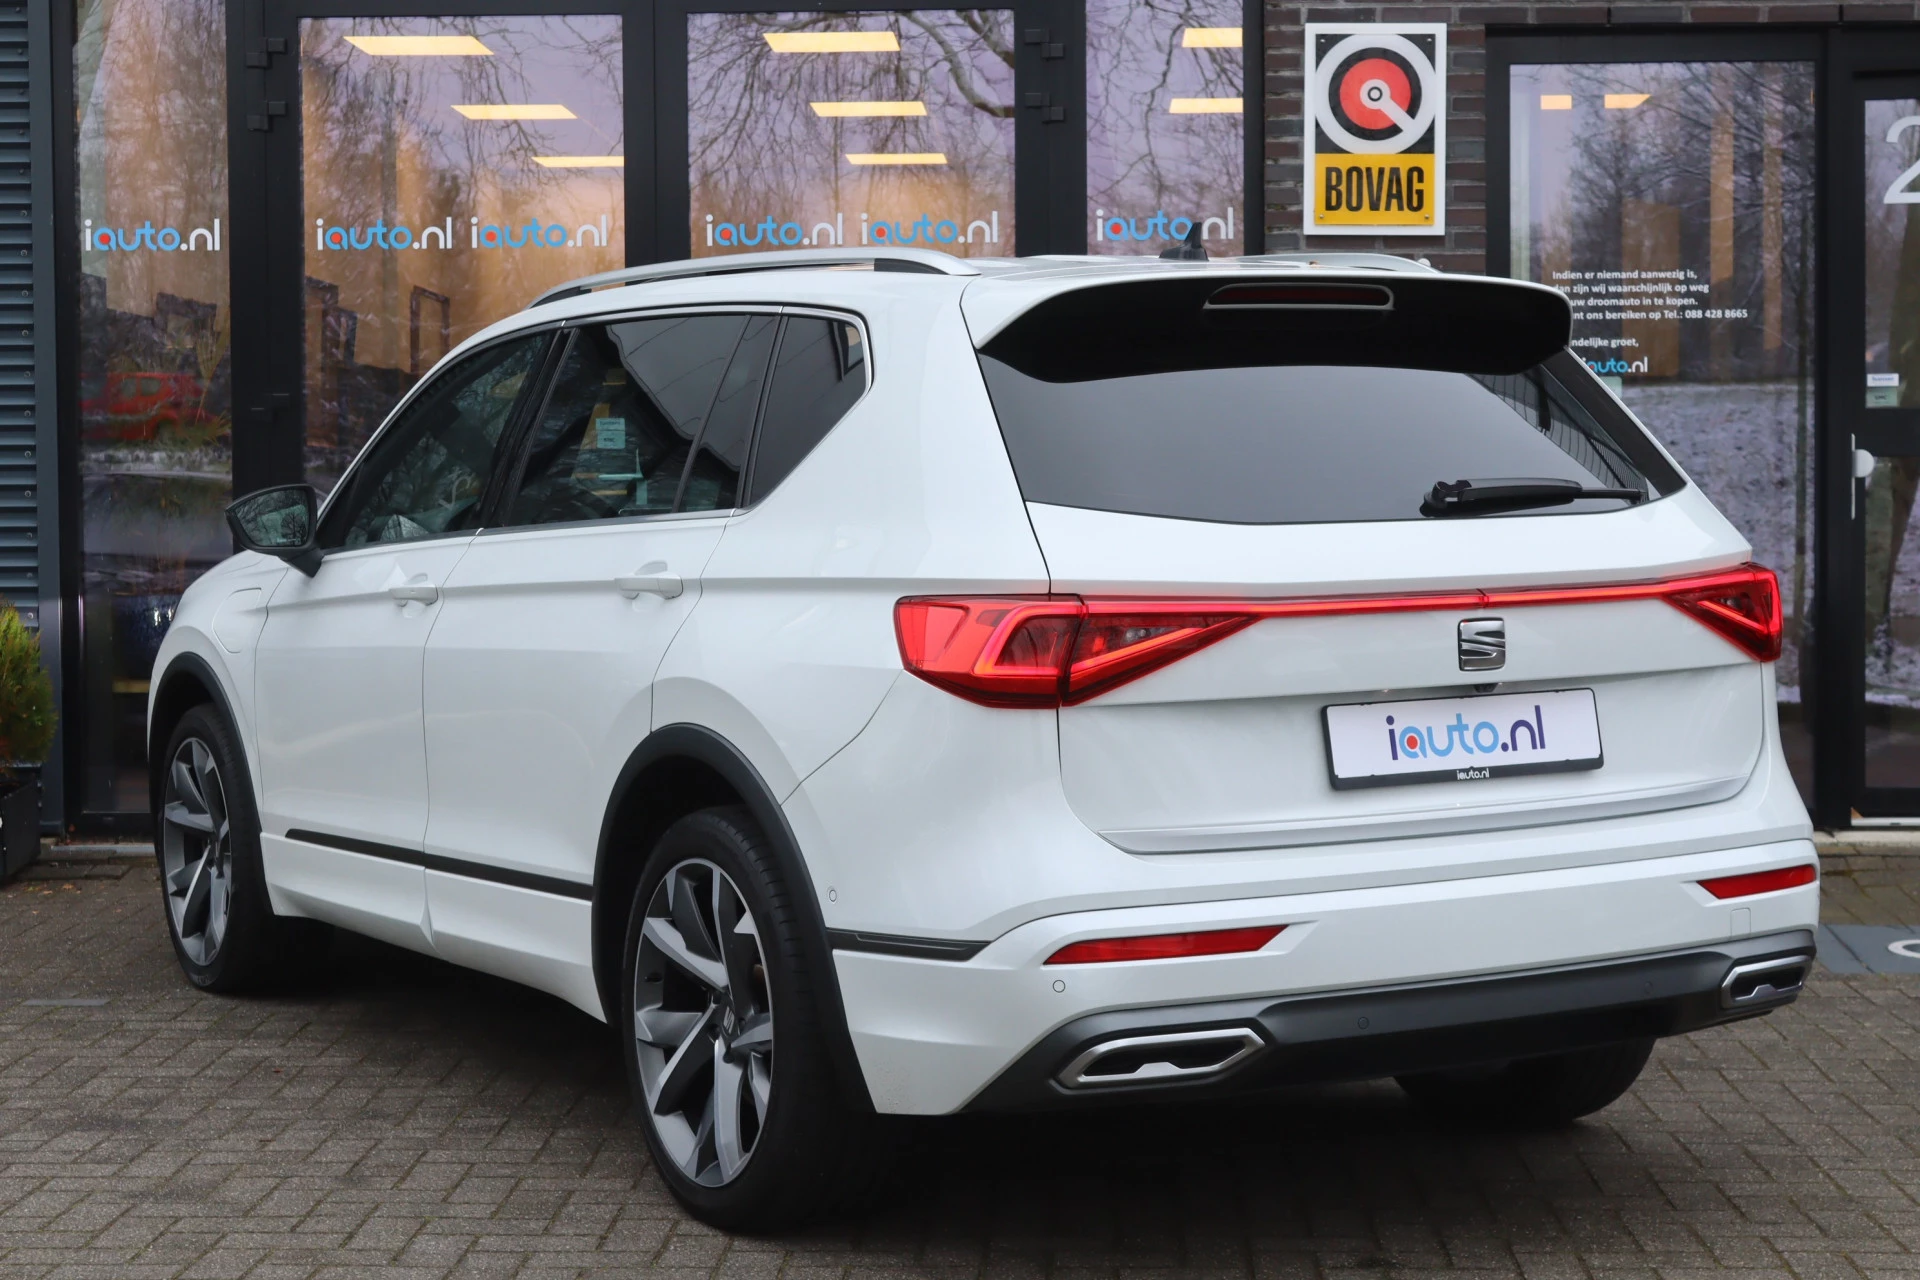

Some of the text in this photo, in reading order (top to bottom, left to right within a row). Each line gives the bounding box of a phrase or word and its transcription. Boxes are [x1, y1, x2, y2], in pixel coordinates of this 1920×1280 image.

[1325, 166, 1425, 212] BOVAG
[84, 218, 220, 251] iauto.nl
[316, 216, 452, 250] iauto.nl
[471, 215, 608, 249] iauto.nl
[706, 213, 843, 246] iauto.nl
[861, 211, 998, 245] iauto.nl
[1096, 207, 1233, 241] iautonl
[1552, 270, 1582, 279] Indien
[1597, 269, 1639, 279] niemand
[1640, 269, 1685, 280] aanwezig
[1687, 269, 1697, 279] is,
[1572, 283, 1589, 294] zijn
[1591, 283, 1606, 294] wij
[1608, 282, 1673, 294] waarschijnlijk
[1674, 284, 1687, 293] op
[1689, 284, 1709, 293] weg
[1586, 311, 1603, 320] ons
[1605, 310, 1646, 319] bereiken
[1649, 311, 1661, 320] op
[1685, 309, 1703, 318] 088
[1704, 309, 1722, 318] 428
[1724, 309, 1748, 318] 8665
[1587, 297, 1641, 306] droomauto
[1642, 297, 1652, 305] in
[1654, 297, 1664, 305] te
[1666, 297, 1698, 307] kopen.
[1610, 338, 1639, 348] groet,
[1385, 704, 1546, 760] iauto.nl
[1456, 767, 1490, 781] iauto.nl
